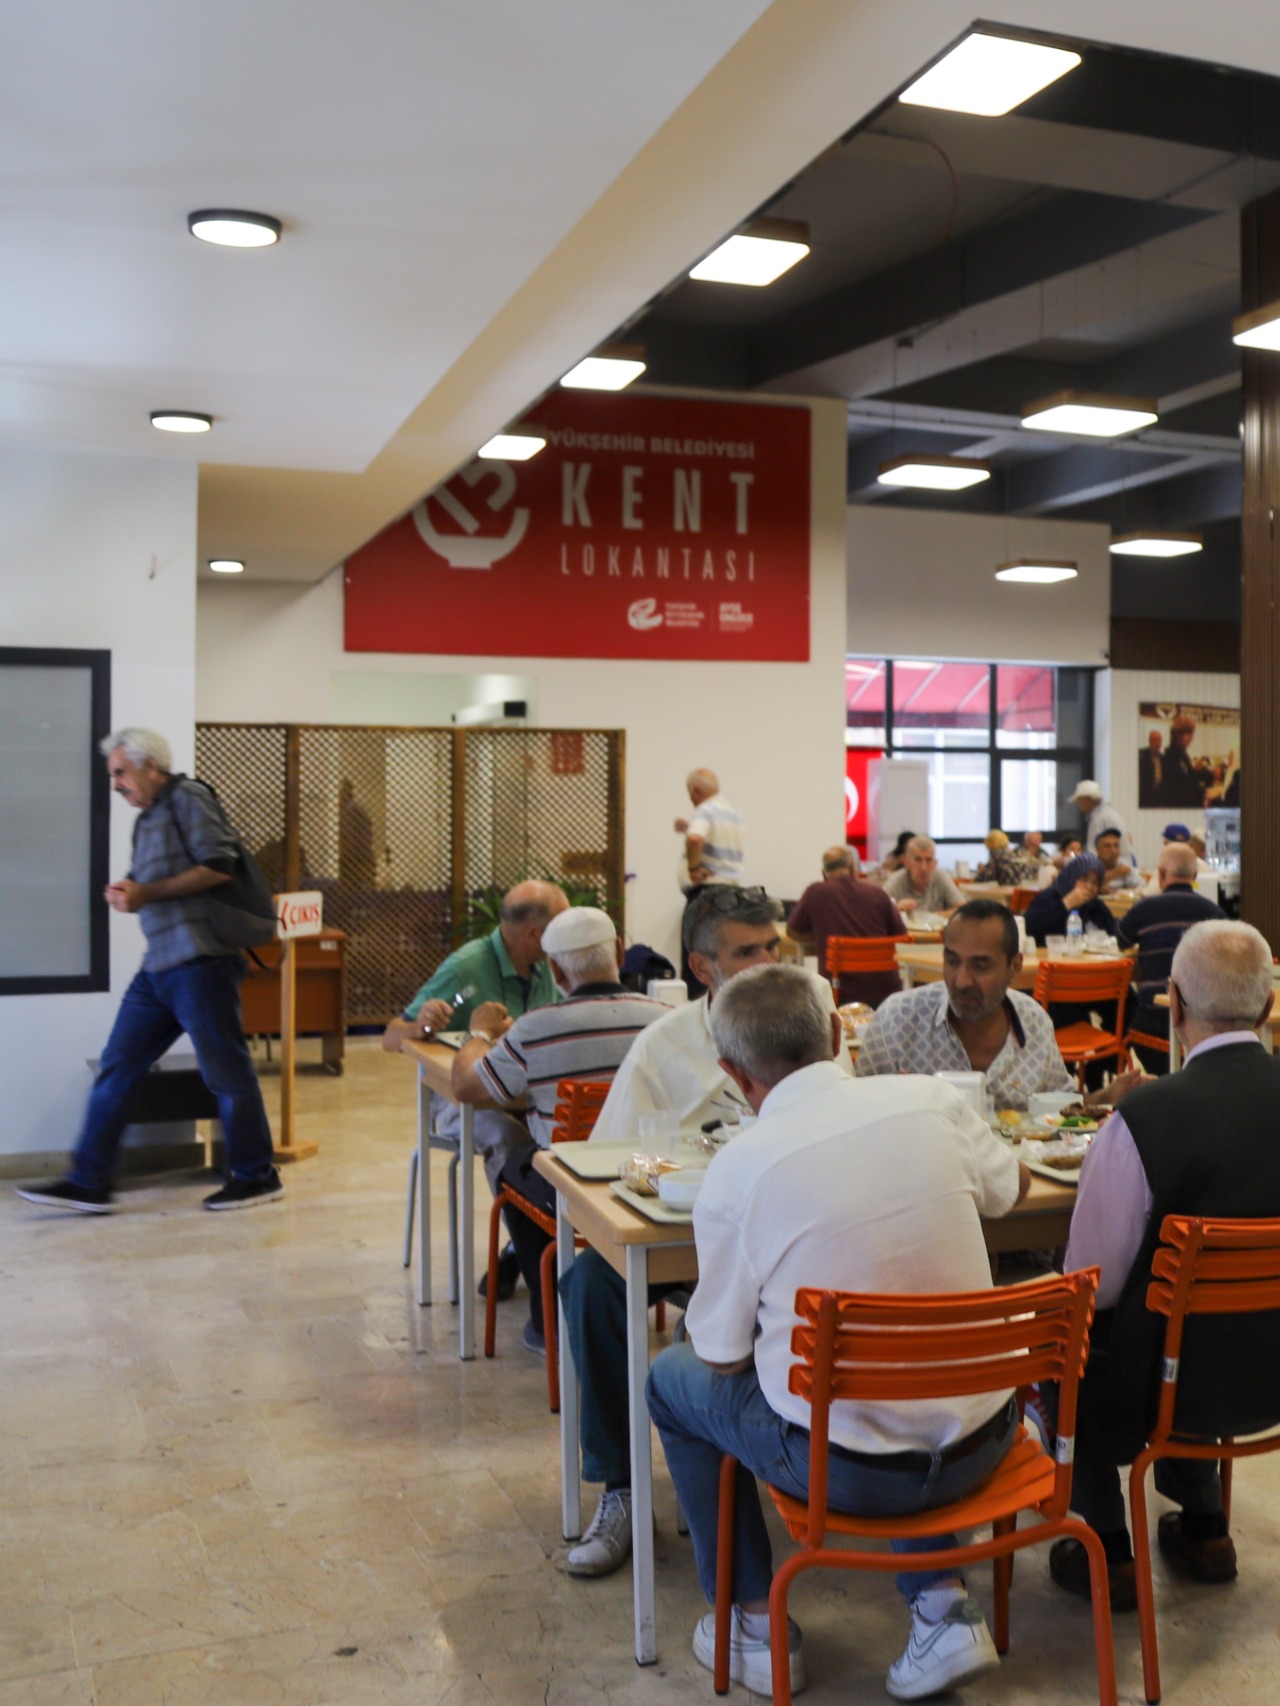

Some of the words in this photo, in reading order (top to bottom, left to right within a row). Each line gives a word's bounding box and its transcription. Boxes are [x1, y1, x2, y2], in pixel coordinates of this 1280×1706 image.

[545, 428, 646, 453] YÜKŞEHİR
[650, 436, 755, 459] BELEDİYESİ
[561, 461, 754, 535] KENT
[560, 542, 754, 582] LOKANTASI
[289, 904, 319, 930] ÇIKIŞ
